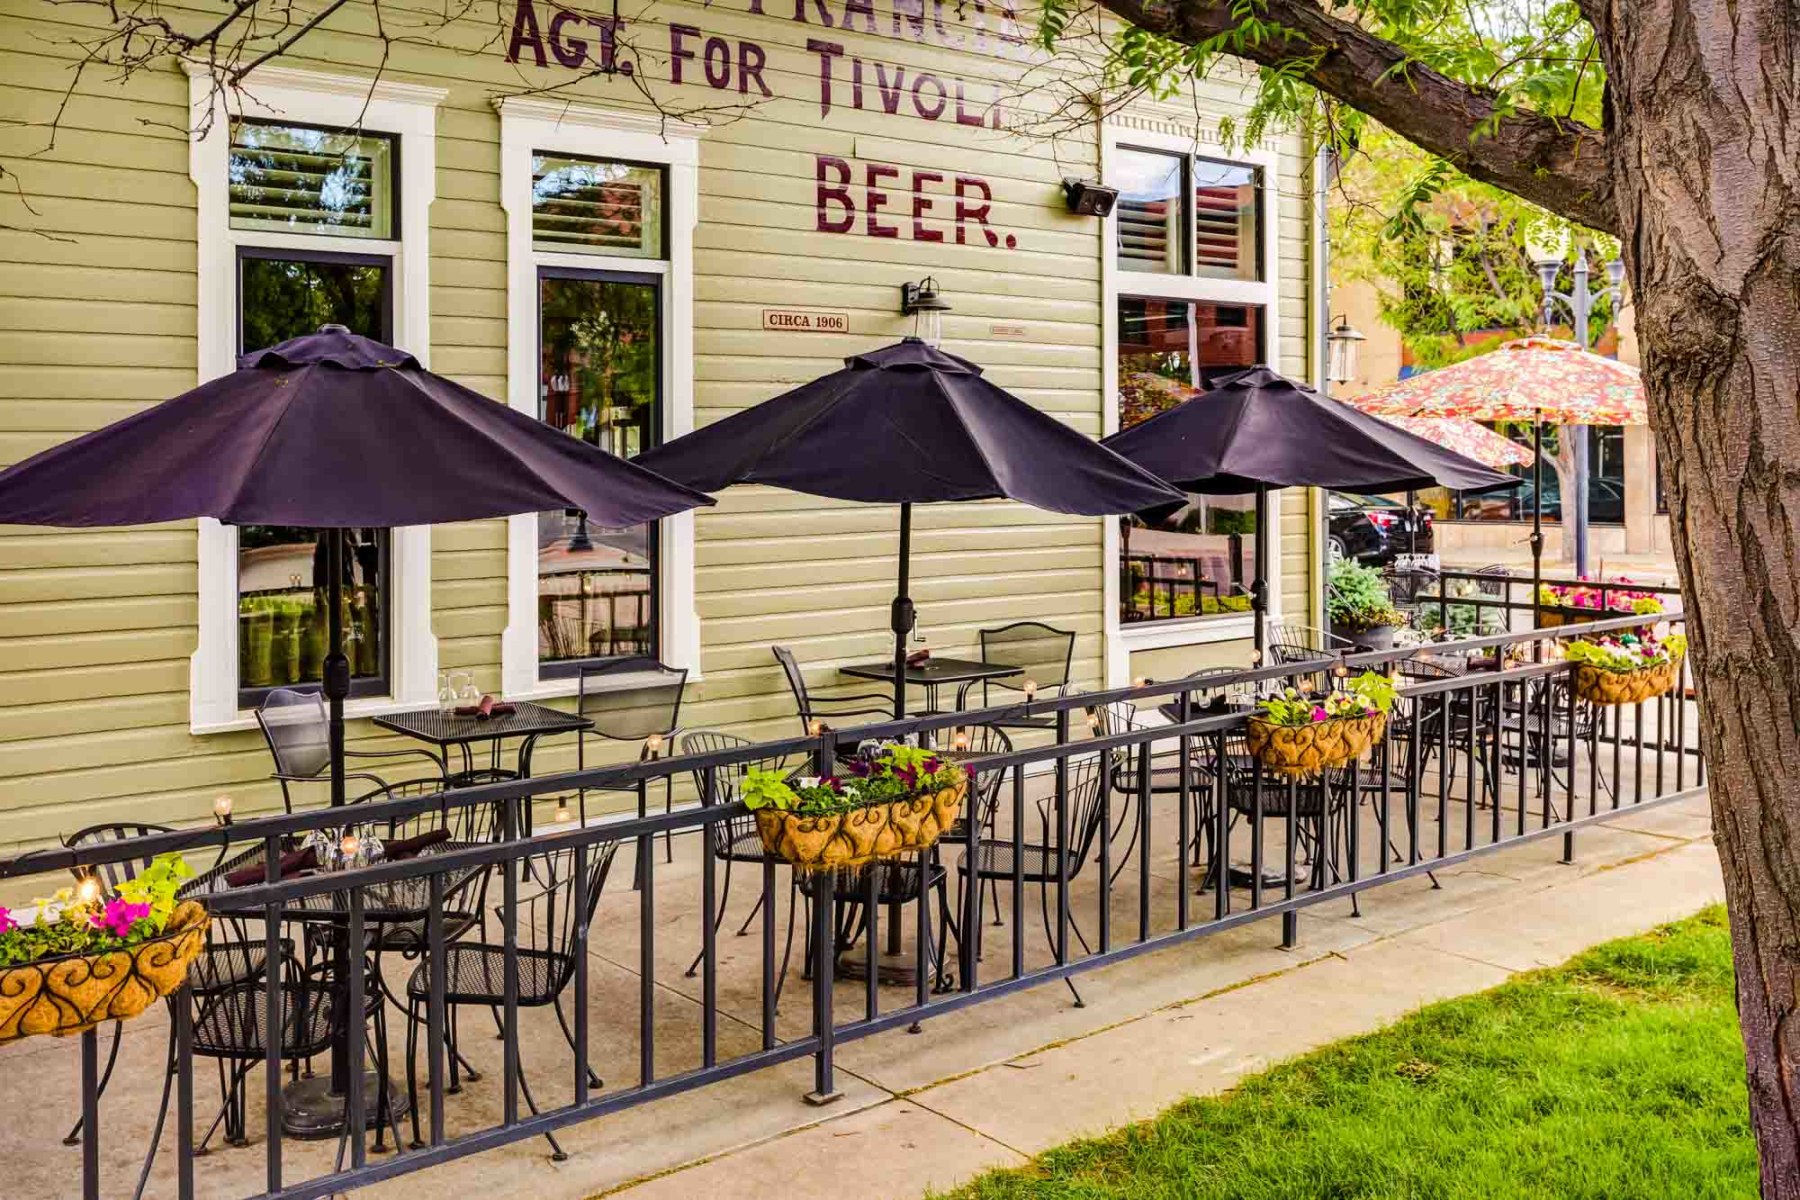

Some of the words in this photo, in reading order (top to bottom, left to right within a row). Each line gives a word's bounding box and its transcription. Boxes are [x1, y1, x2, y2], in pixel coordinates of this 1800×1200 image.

[504, 0, 634, 77] AGT.
[669, 22, 773, 97] FOR
[806, 38, 1003, 130] TIVOLI
[816, 156, 1017, 249] BEER.
[769, 314, 810, 327] CIRCA
[816, 316, 843, 328] 1906
